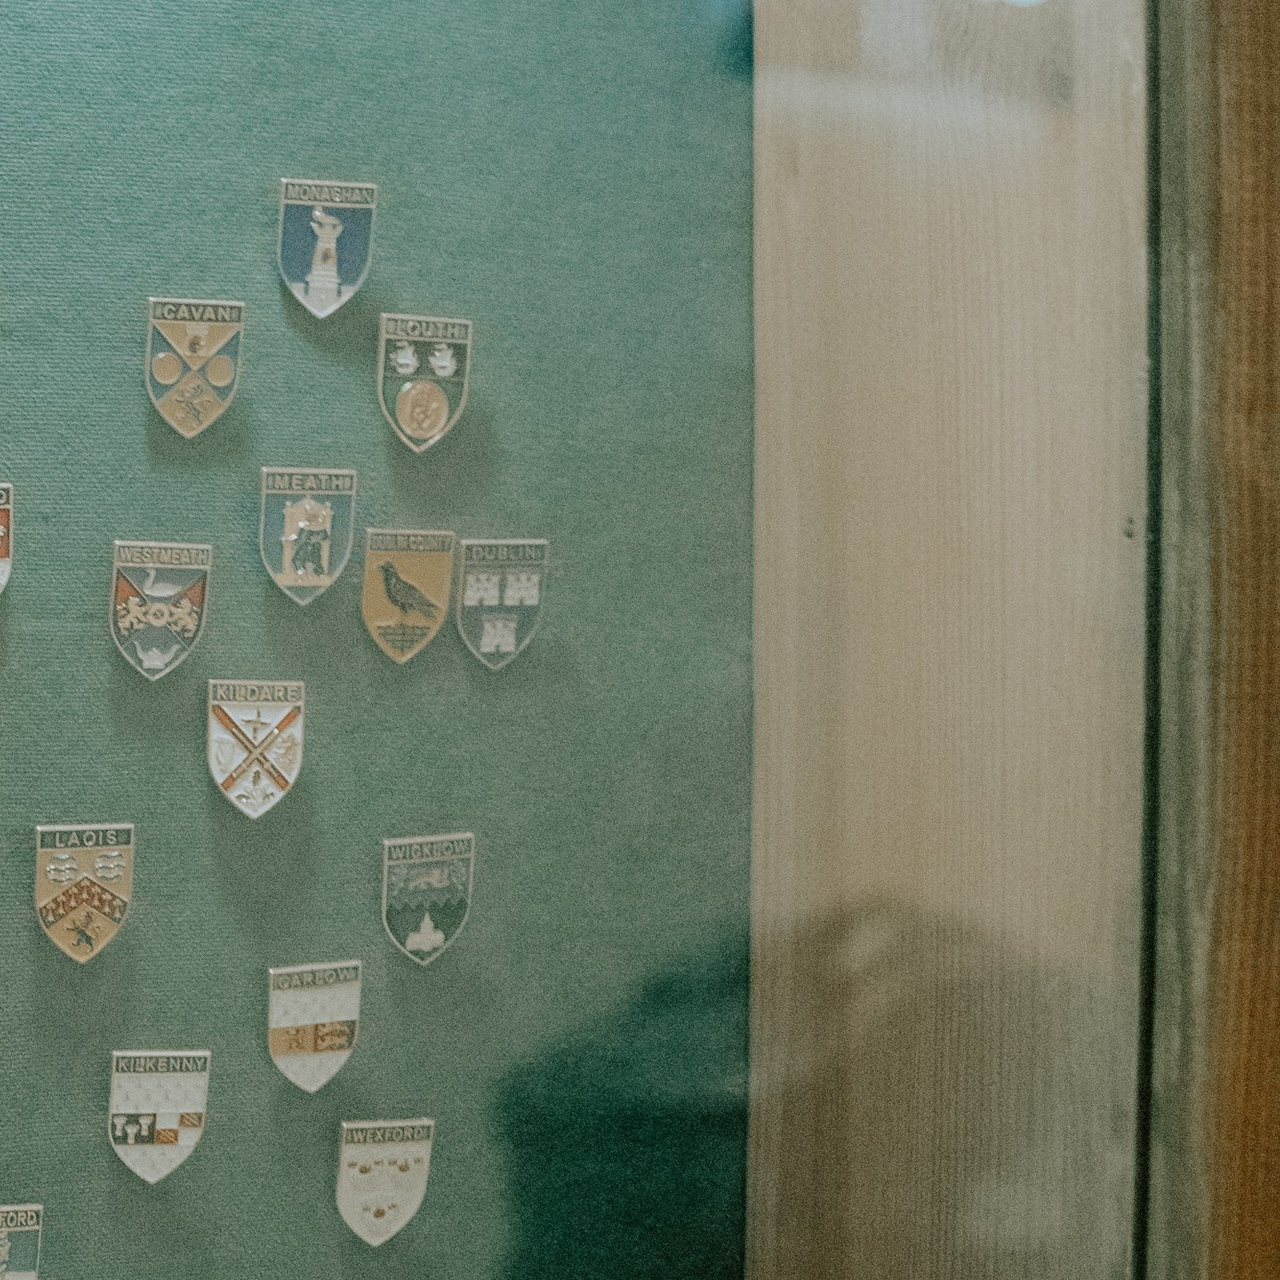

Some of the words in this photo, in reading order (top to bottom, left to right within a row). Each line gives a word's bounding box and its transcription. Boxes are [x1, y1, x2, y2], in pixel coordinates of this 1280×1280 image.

[286, 185, 372, 204] MONAGHAN
[162, 305, 231, 322] CAVAN
[397, 320, 460, 339] LOUTH
[273, 474, 345, 491] MEATH
[119, 548, 209, 565] WESTMEATH
[471, 546, 537, 561] DUBLIN
[216, 684, 301, 703] KILDARE
[54, 829, 119, 848] LAOIS
[390, 839, 469, 860] WICKLOW
[278, 966, 353, 989] CARLOW
[116, 1056, 206, 1073] KILKENNY
[351, 1126, 423, 1144] WEXFORD
